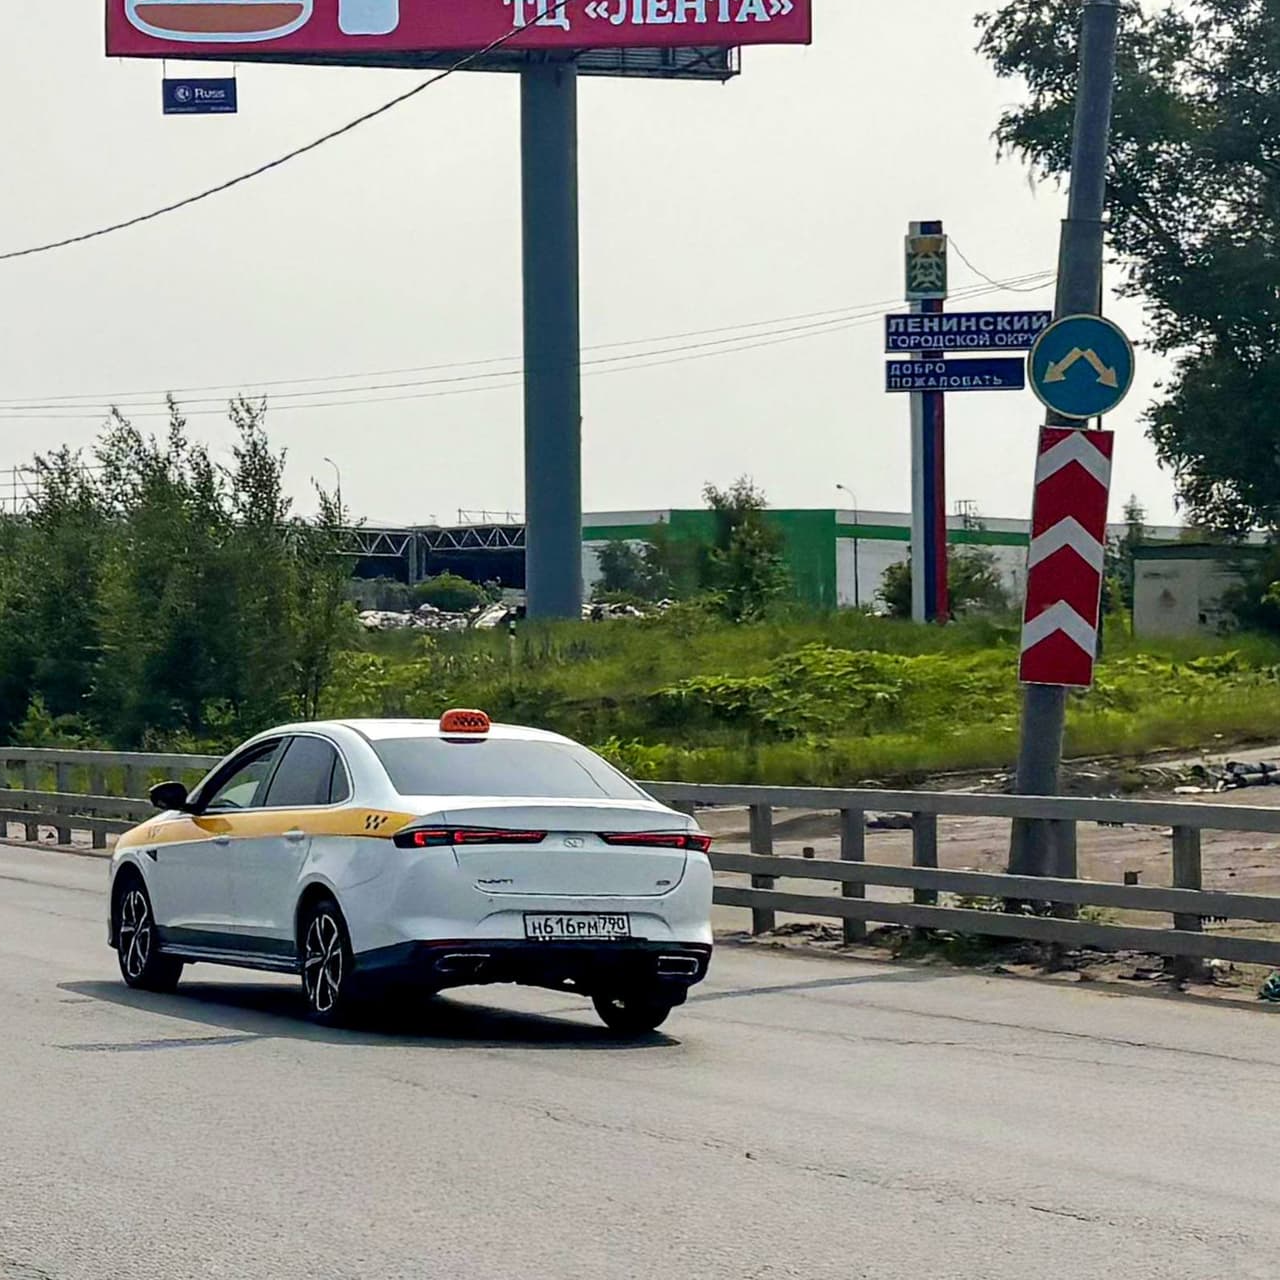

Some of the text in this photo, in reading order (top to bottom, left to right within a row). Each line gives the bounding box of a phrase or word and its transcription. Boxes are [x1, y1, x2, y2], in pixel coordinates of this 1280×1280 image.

[888, 331, 1038, 348] ГОРОДСКОЙ ОКРУ
[890, 362, 946, 376] ДОБРО
[890, 375, 1003, 388] ПОЖАЛОВАТЬ
